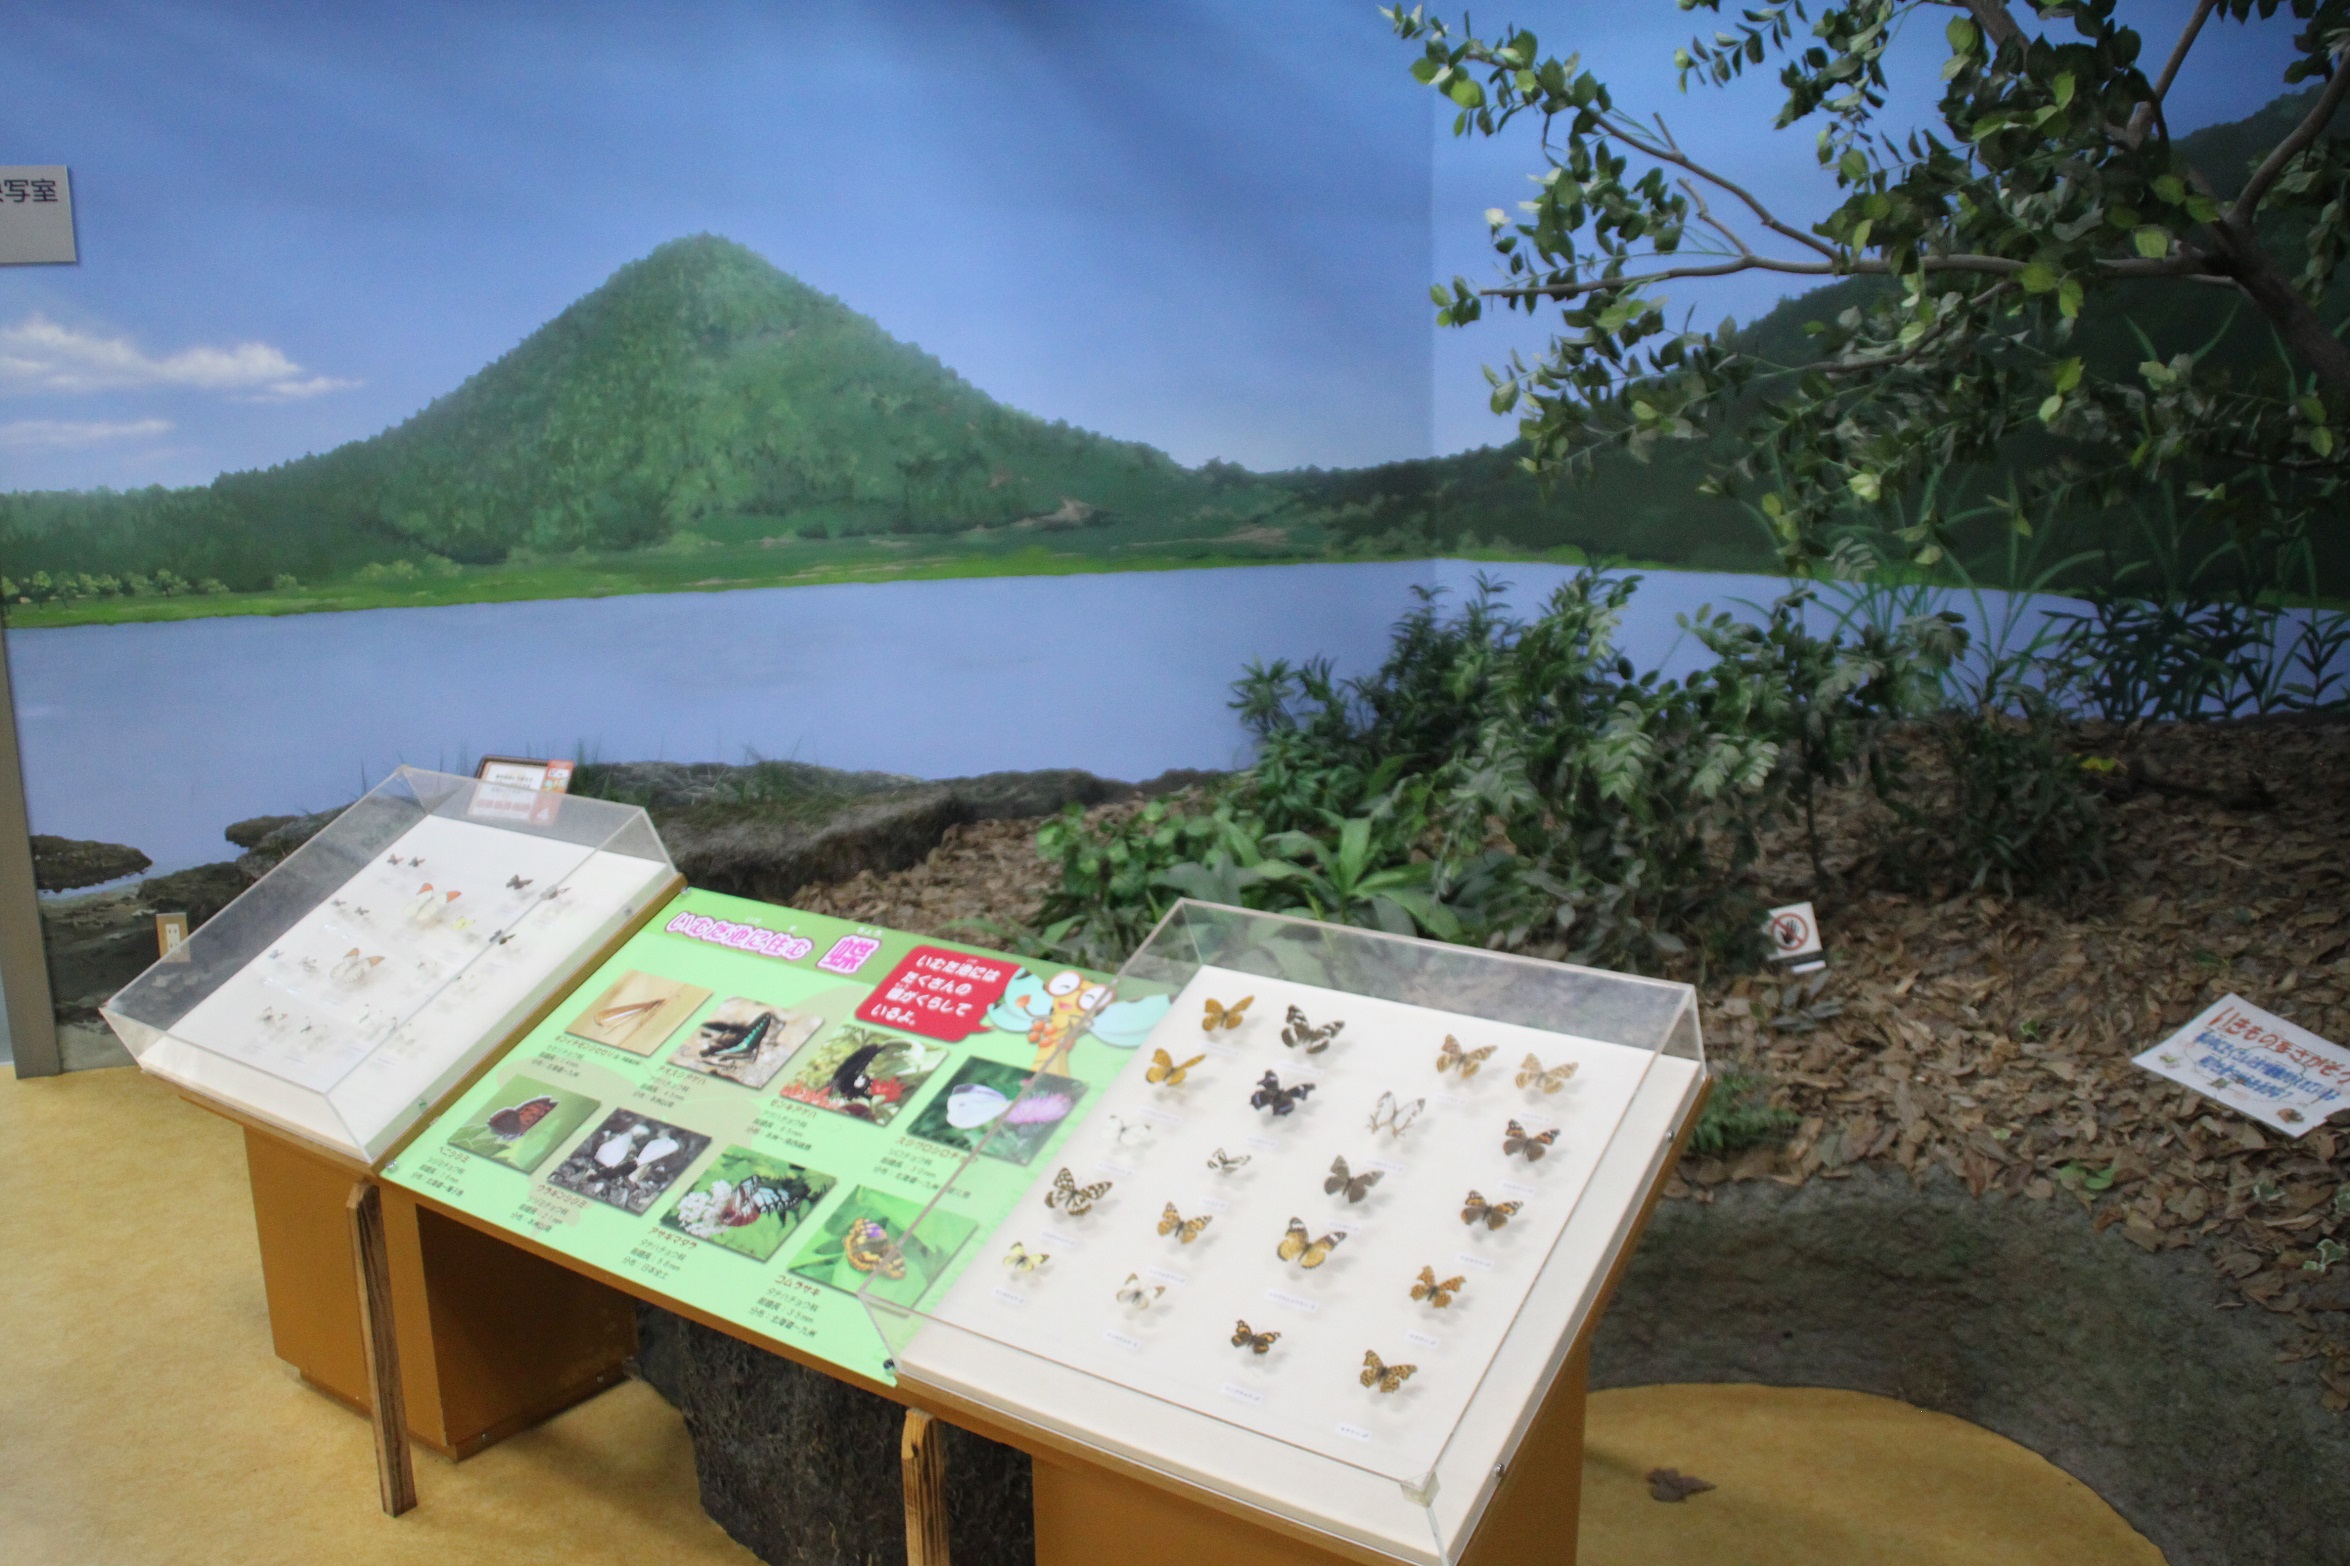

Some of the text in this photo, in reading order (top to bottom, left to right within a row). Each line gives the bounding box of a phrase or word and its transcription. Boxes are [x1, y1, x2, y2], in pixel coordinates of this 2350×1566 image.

[665, 911, 881, 974] いむた池に住む 蝶
[901, 971, 973, 996] たくさんの
[871, 1003, 916, 1026] いるよ。
[2208, 1006, 2350, 1085] いきものをさがそう
[646, 1226, 699, 1251] アサギマダラ
[773, 1273, 823, 1298] コムラサキ
